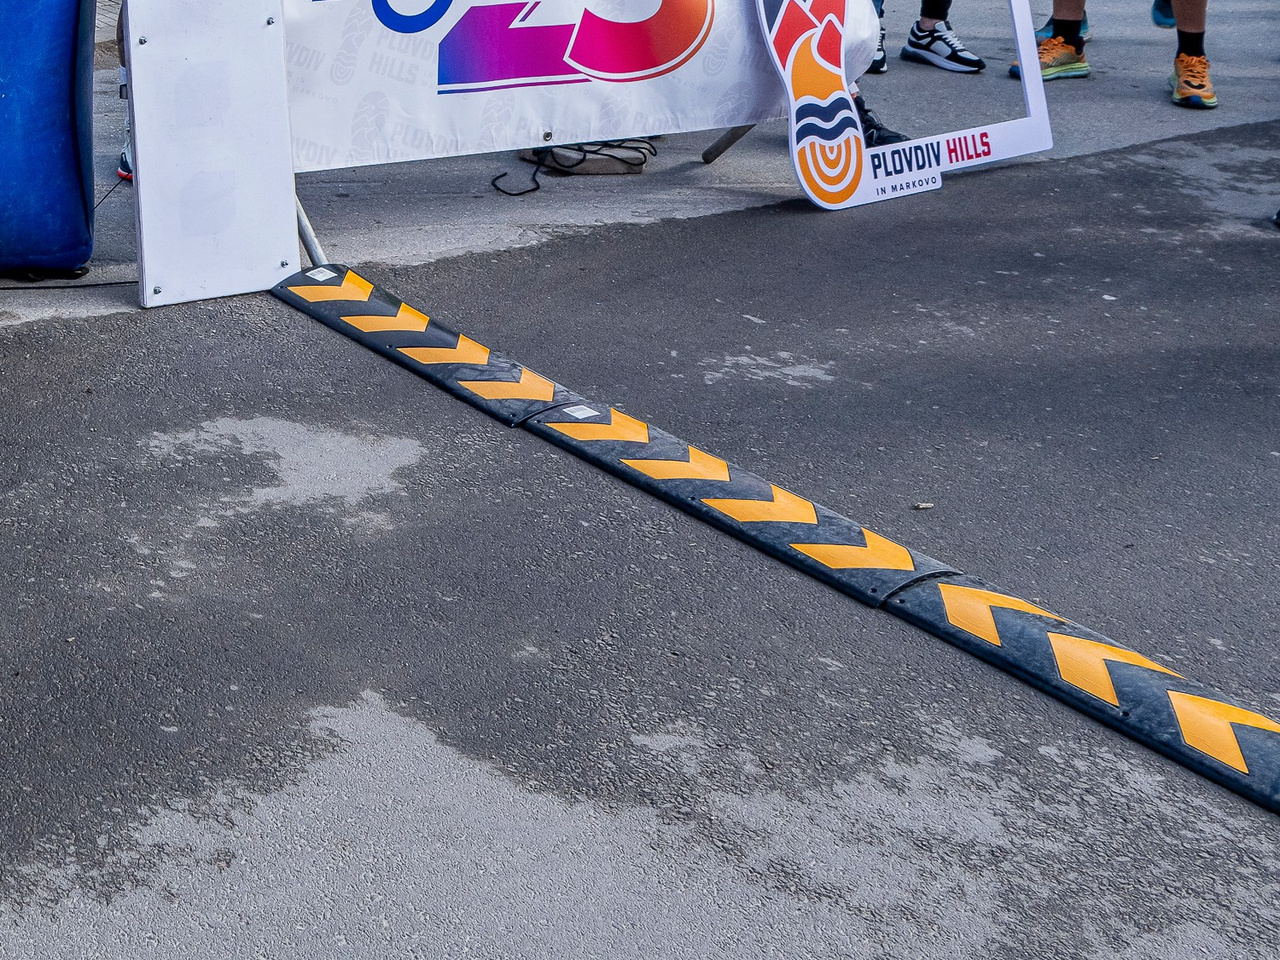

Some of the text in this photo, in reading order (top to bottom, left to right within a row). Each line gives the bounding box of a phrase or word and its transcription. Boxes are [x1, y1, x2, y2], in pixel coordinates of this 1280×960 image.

[370, 51, 419, 86] HILLS
[870, 132, 992, 180] PLOVDIV HILLS
[875, 176, 937, 196] IN MARKOVO
